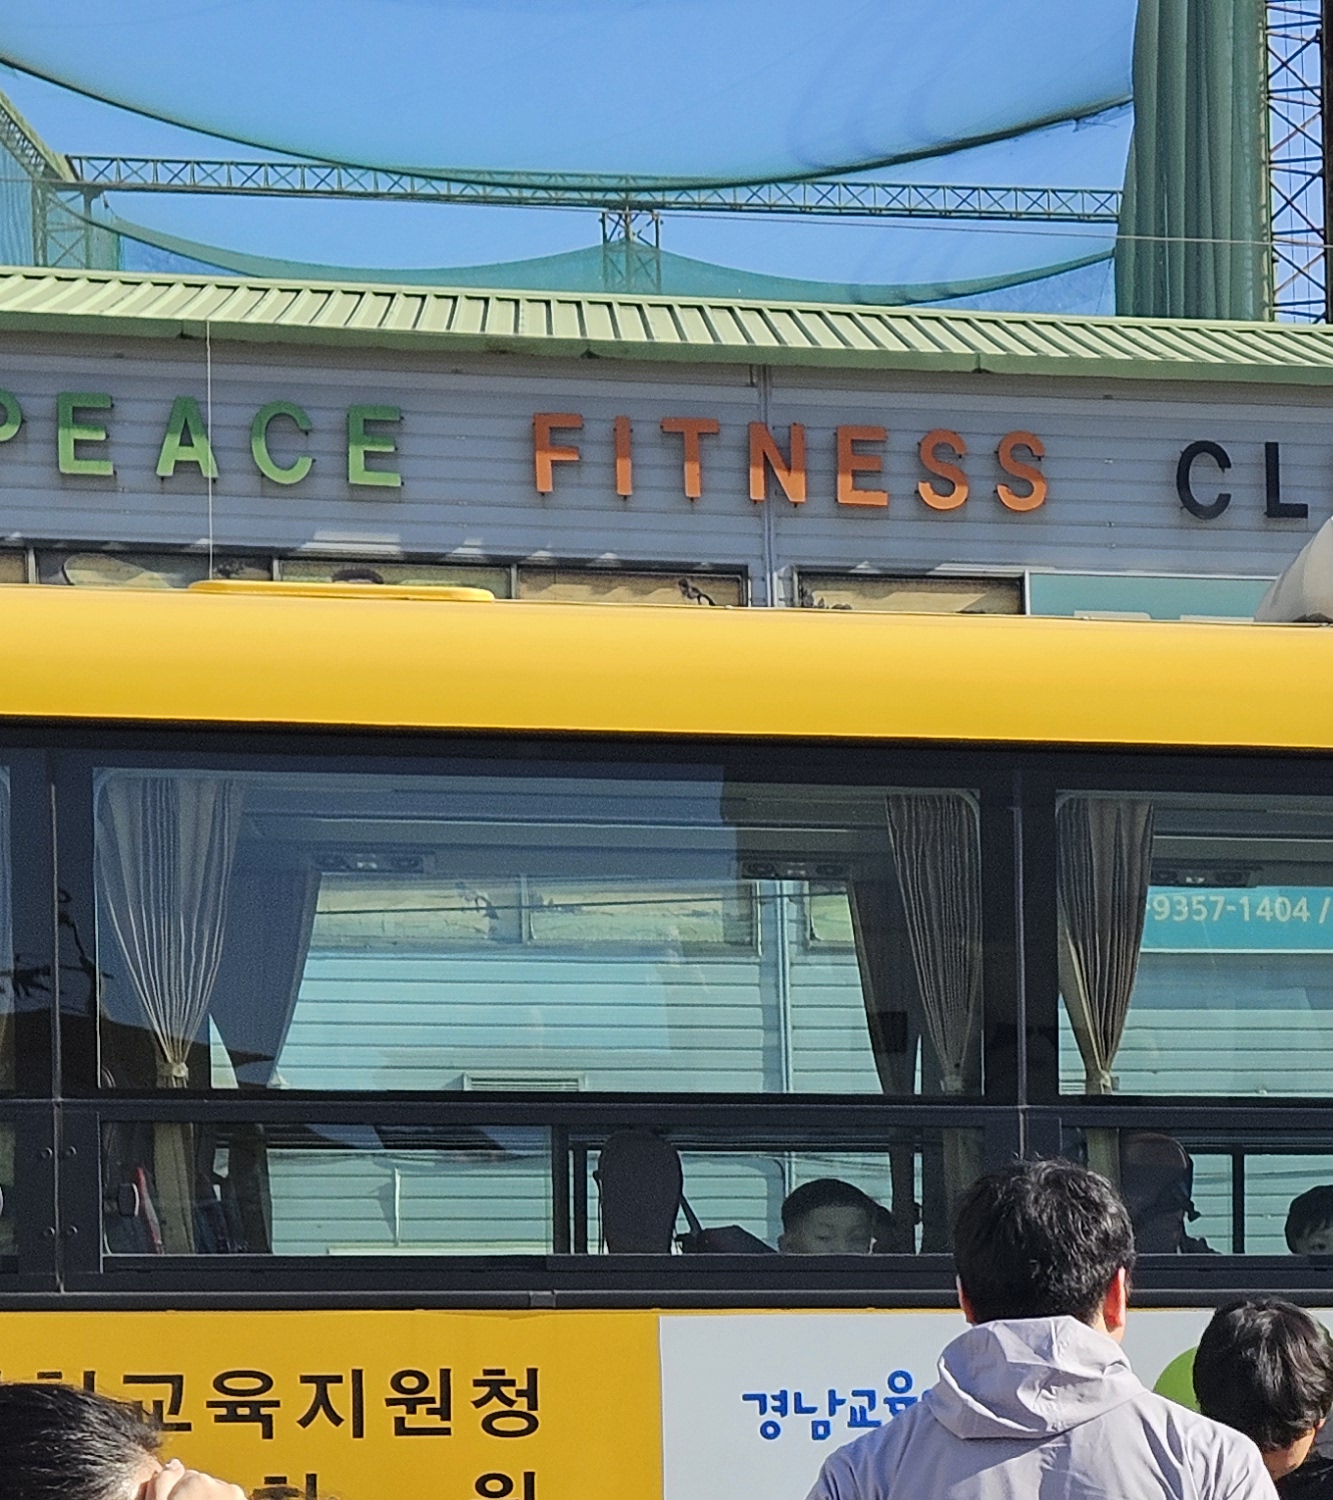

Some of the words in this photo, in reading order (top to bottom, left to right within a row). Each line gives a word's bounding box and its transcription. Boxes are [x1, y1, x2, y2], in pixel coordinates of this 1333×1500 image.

[533, 411, 1048, 512] FITNESS
[36, 1367, 540, 1440] 교육지원청
[742, 1370, 933, 1441] 경남교육
